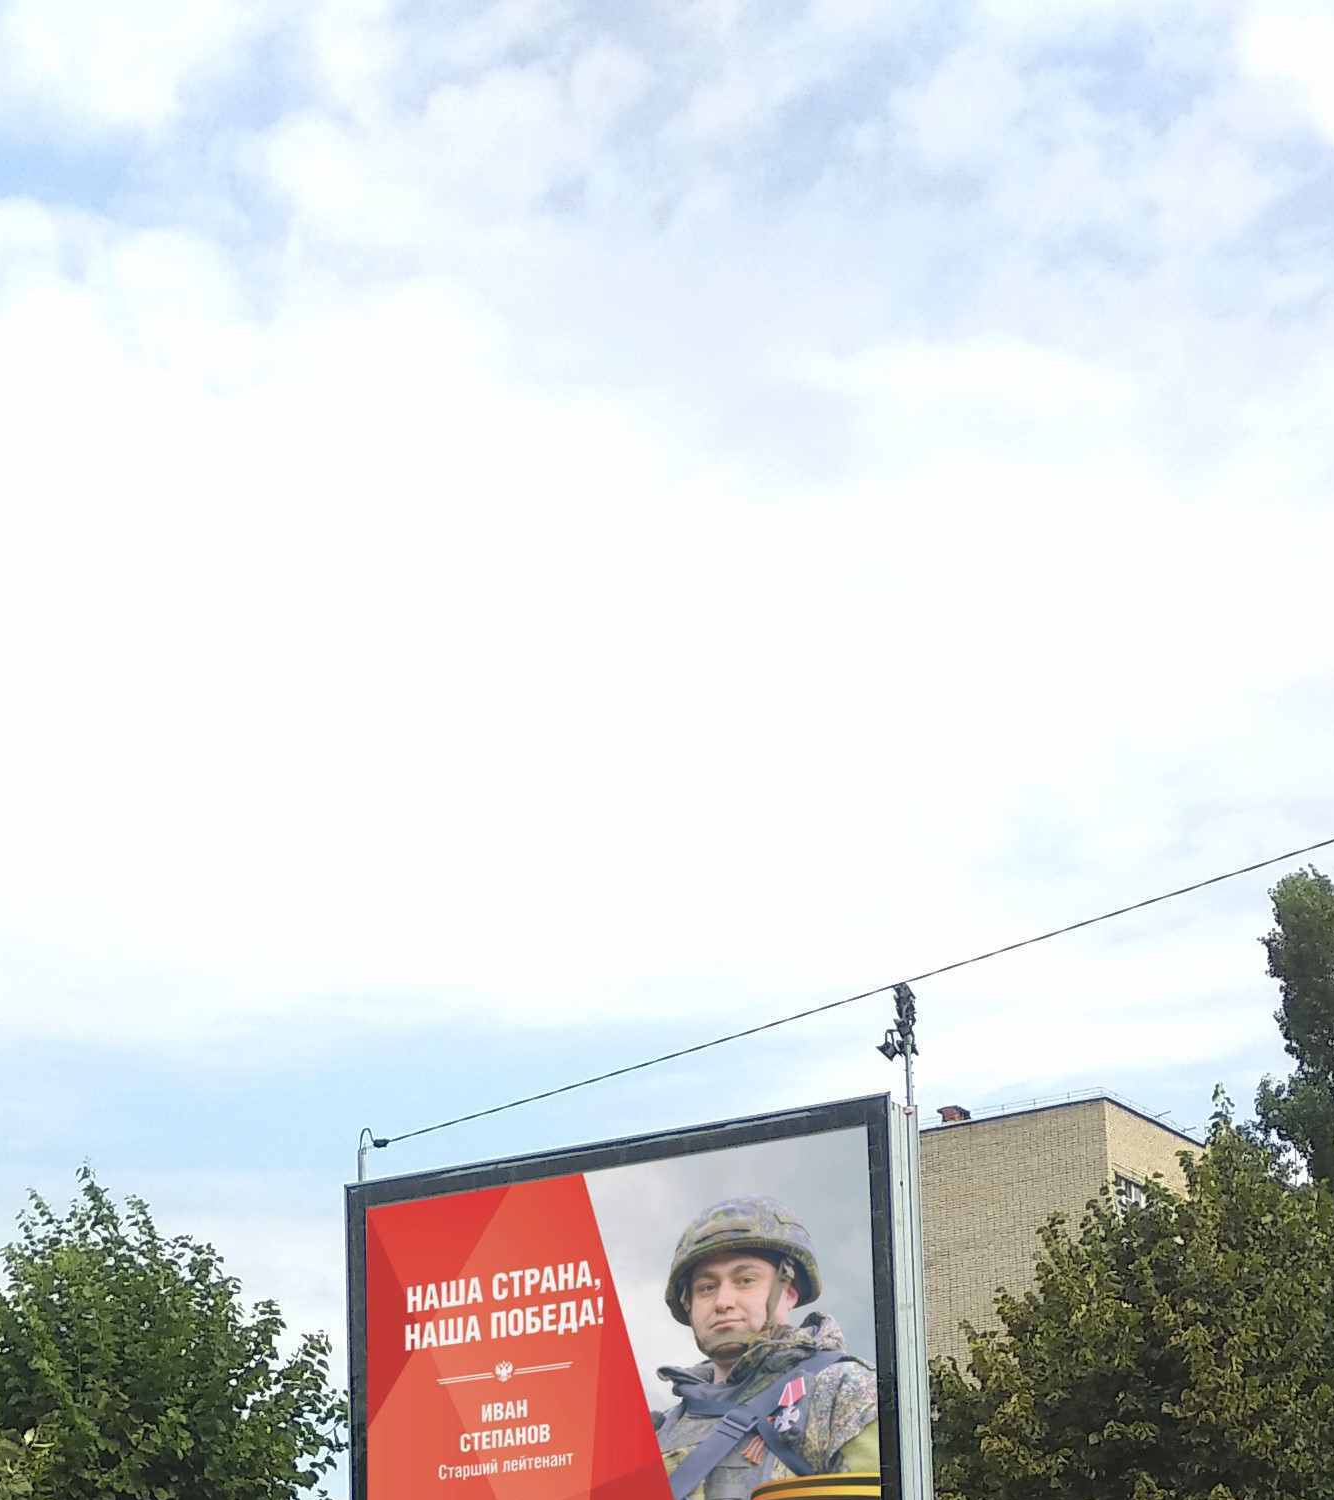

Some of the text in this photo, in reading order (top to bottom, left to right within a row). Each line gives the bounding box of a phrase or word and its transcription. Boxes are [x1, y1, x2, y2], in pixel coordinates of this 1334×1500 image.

[407, 1260, 602, 1313] НАША СТРАНА,
[405, 1296, 604, 1351] НАША ПОБЕДА!
[481, 1399, 528, 1423] ИВАН
[460, 1423, 551, 1452] СТЕПАНОВ
[438, 1452, 574, 1480] Старший лейтенант
